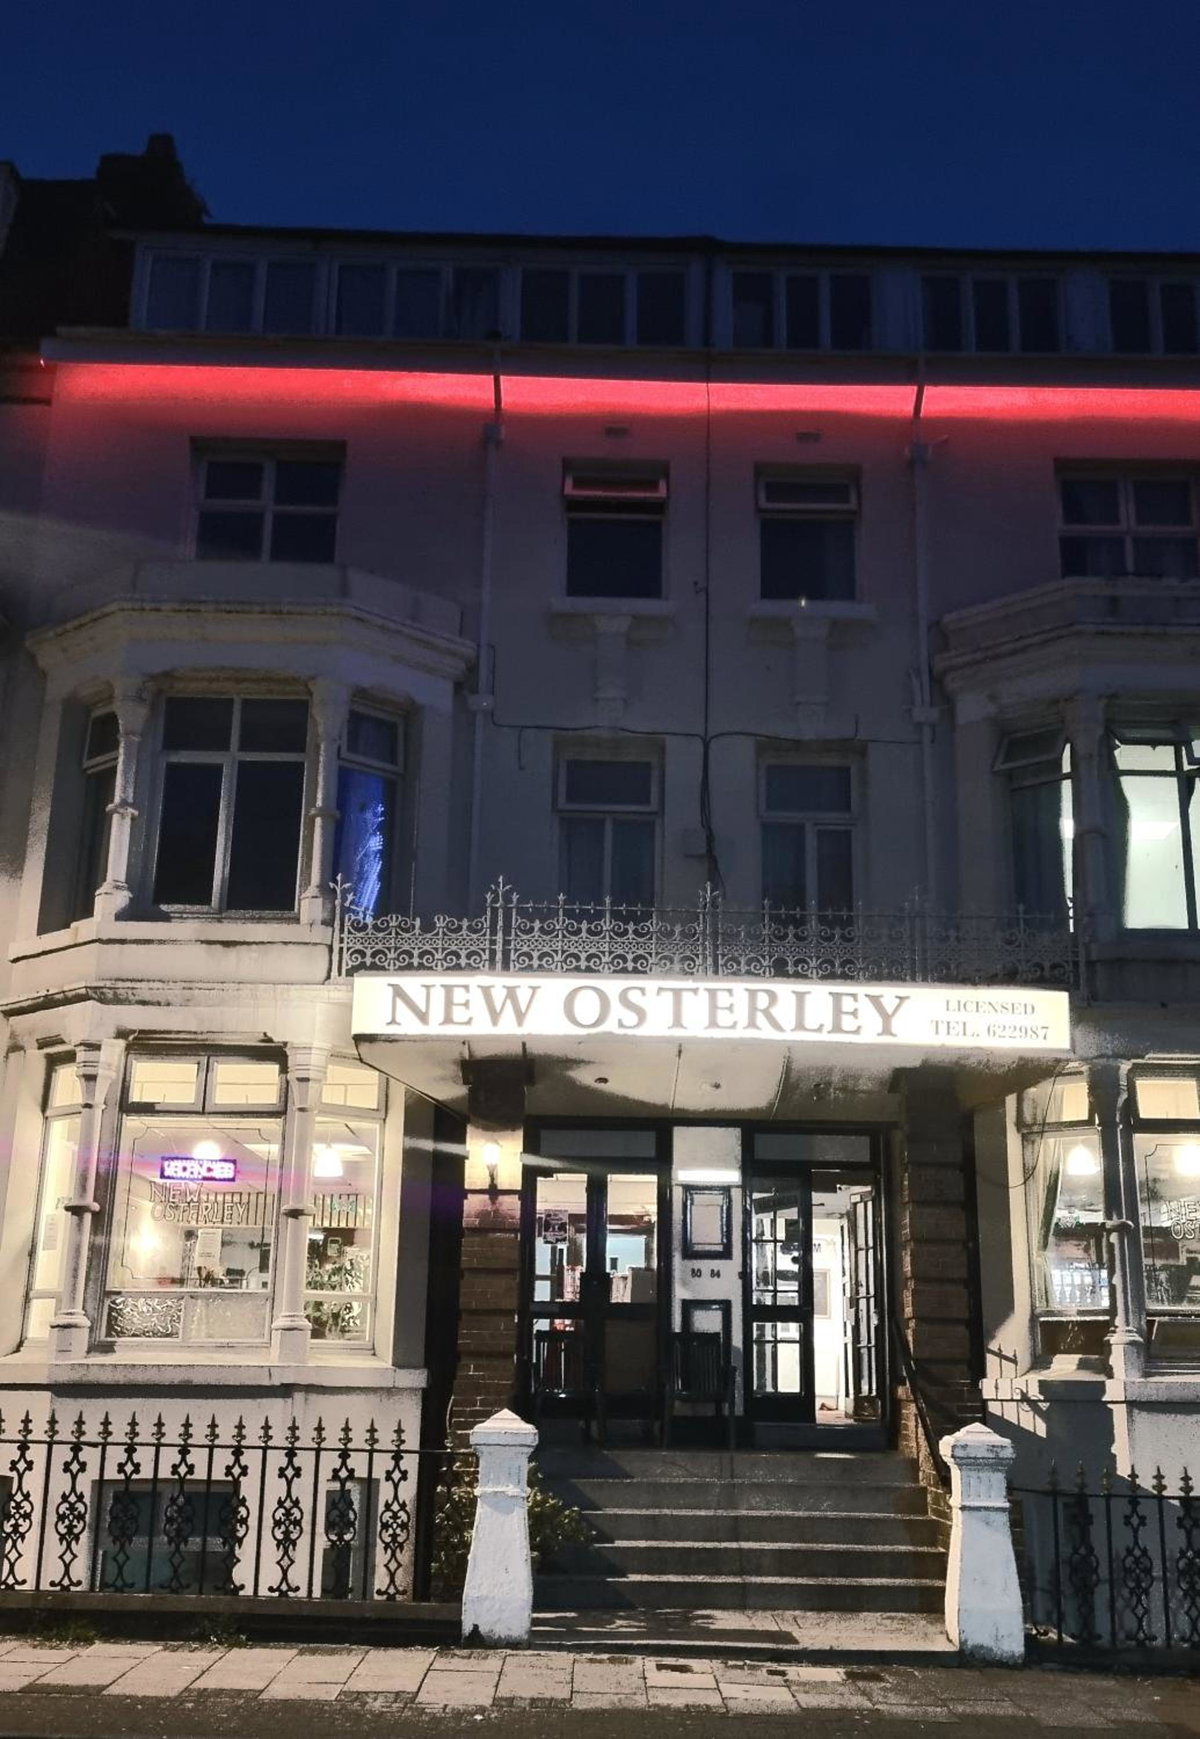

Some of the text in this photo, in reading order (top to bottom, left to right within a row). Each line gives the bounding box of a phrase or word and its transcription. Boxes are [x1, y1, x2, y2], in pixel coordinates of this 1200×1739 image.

[386, 982, 911, 1038] NEW OSTERLEY
[945, 999, 1036, 1017] LICENSED
[930, 1019, 1050, 1042] TEL. 622987
[163, 1159, 235, 1179] VACANCIES
[149, 1181, 204, 1204] NEW
[150, 1201, 248, 1225] OSTERLEY
[1165, 1198, 1200, 1222] NE
